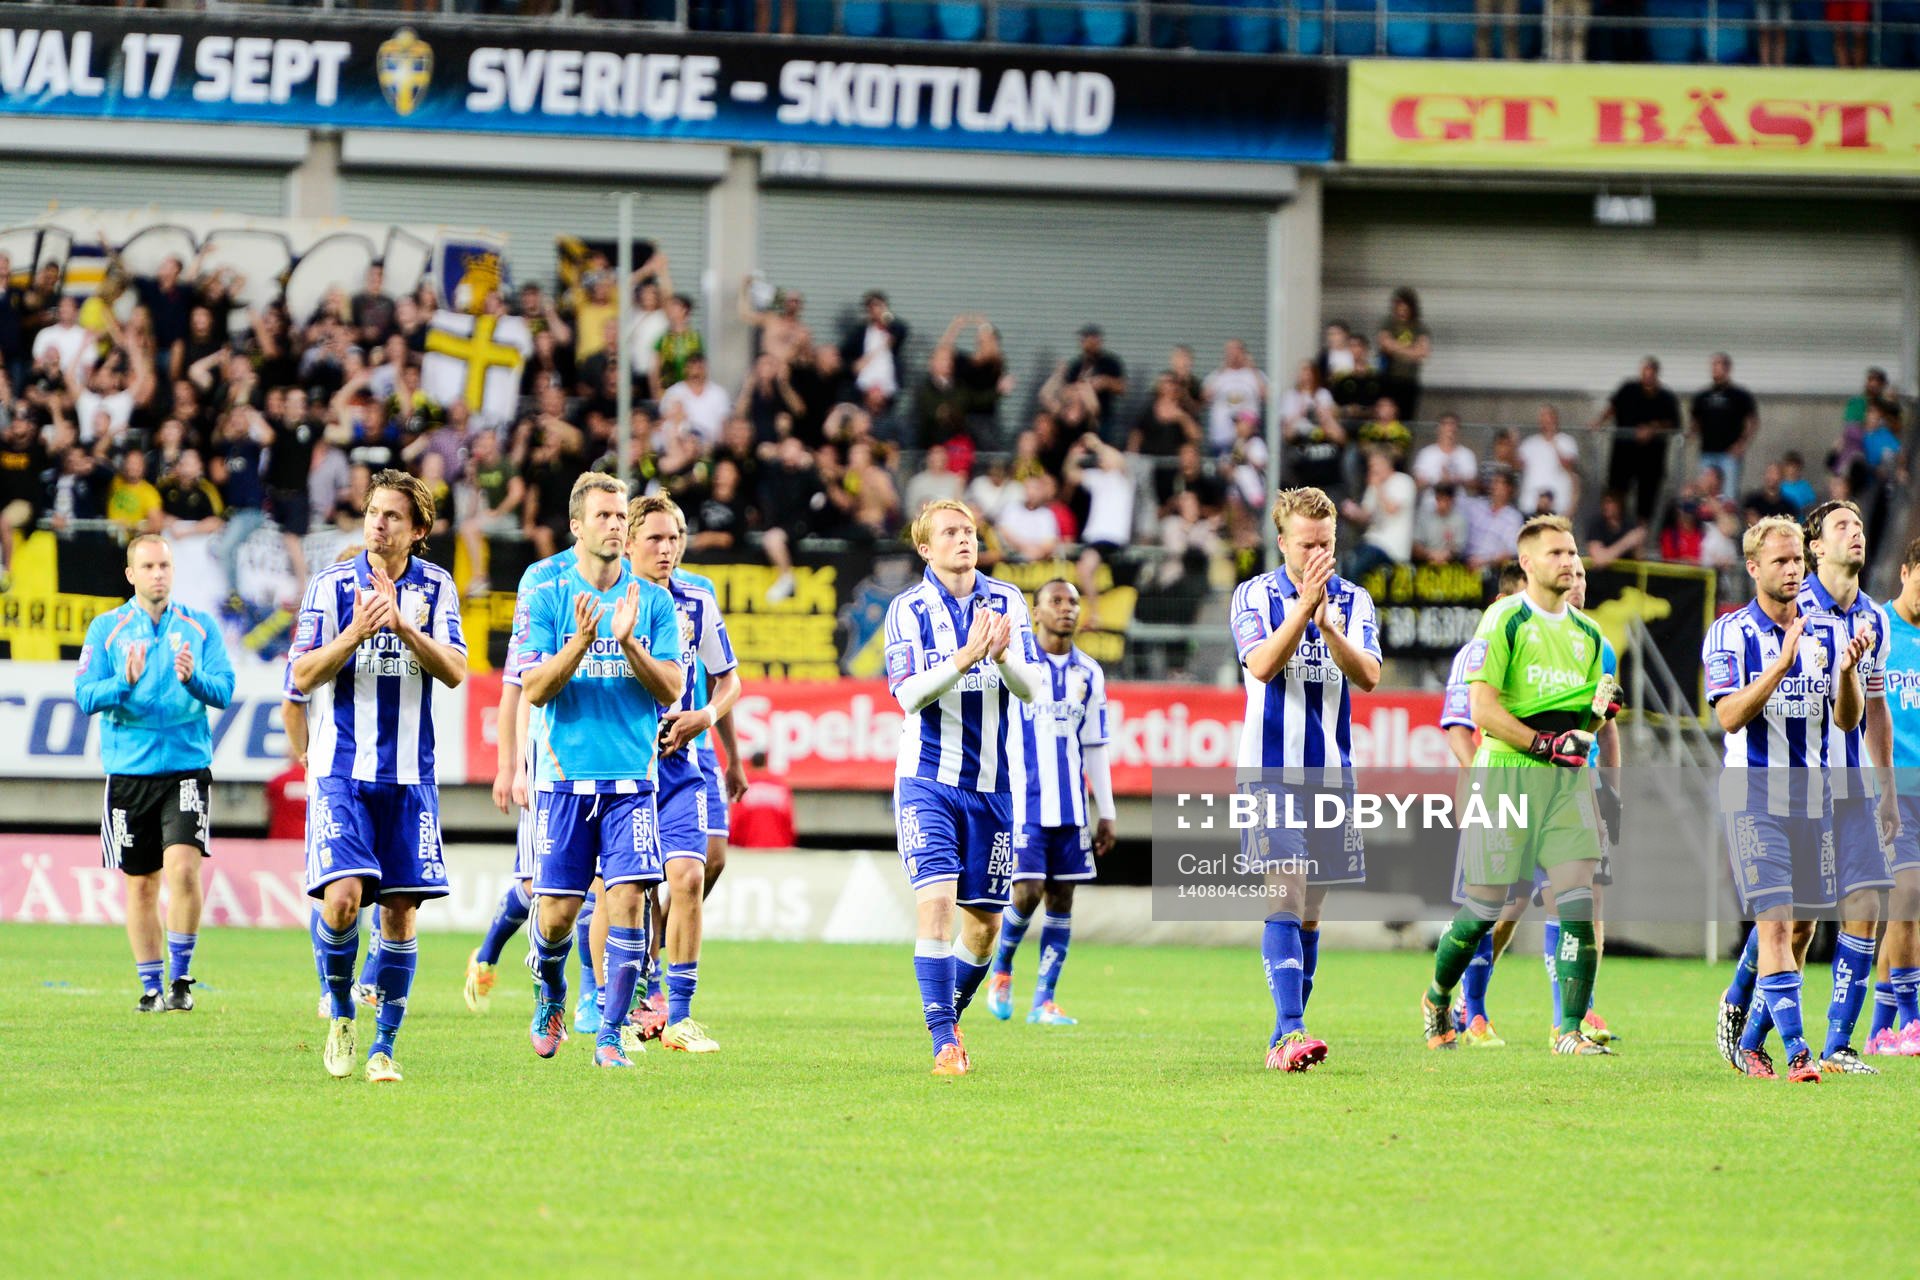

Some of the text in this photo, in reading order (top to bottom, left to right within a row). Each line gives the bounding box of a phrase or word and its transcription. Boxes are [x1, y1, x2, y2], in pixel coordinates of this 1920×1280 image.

[0, 28, 104, 97] VAL
[121, 33, 182, 99] 17
[193, 36, 350, 105] SEPT
[466, 48, 720, 120] SVERIGE
[777, 61, 1114, 135] SKOTTLAND
[1389, 95, 1557, 143] GT
[1593, 89, 1892, 151] BÄST
[358, 653, 419, 675] Finans
[1285, 660, 1339, 681] Finans
[1765, 697, 1820, 716] Finans
[733, 695, 904, 775] Spela
[632, 808, 652, 823] SE
[901, 806, 918, 820] SE
[633, 822, 652, 837] RN
[902, 820, 919, 837] RN
[1736, 816, 1755, 832] SE
[904, 833, 928, 852] EKE
[993, 832, 1010, 847] SE
[990, 847, 1010, 862] RN
[421, 862, 445, 880] 29
[988, 878, 1011, 895] 17
[1833, 958, 1852, 1003] SKF
